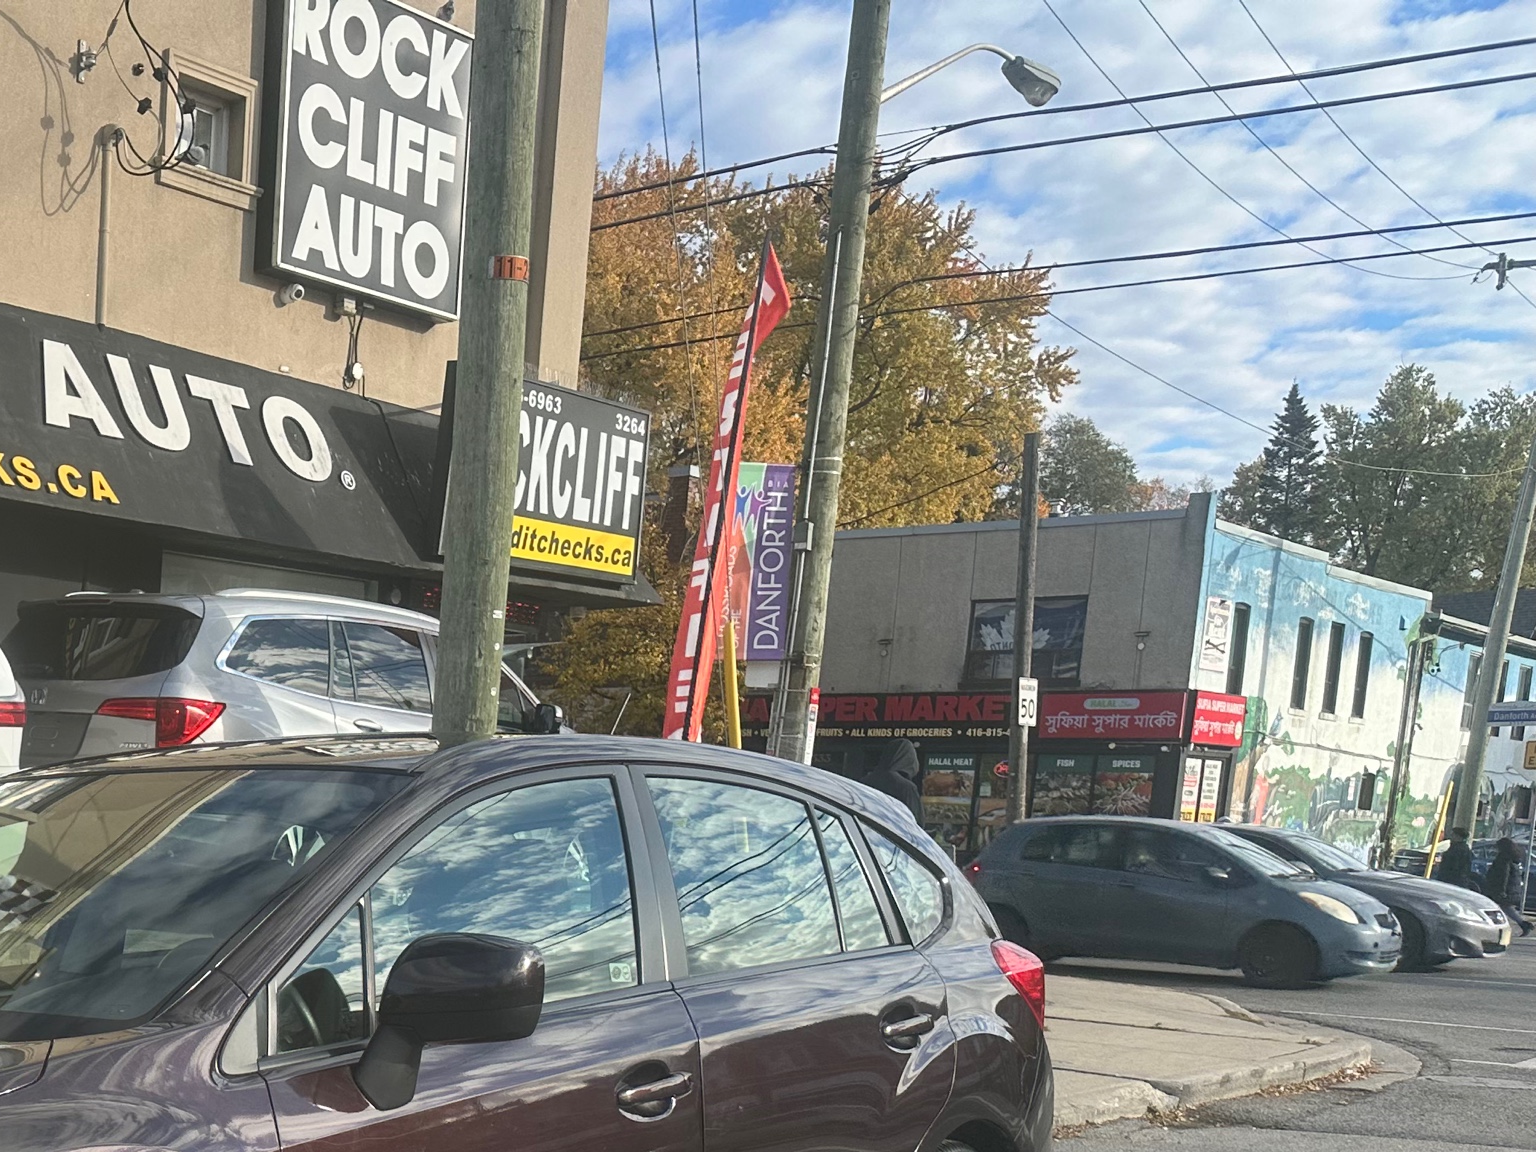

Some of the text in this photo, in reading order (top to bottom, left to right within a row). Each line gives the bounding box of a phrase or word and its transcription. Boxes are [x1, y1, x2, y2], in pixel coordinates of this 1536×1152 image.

[293, 0, 470, 120] ROCK
[298, 83, 457, 207] CLIFF
[291, 184, 450, 300] AUTO
[42, 338, 333, 482] AUTO
[615, 413, 646, 436] 3264
[767, 480, 789, 488] BIA
[753, 492, 788, 650] DANFORTH
[1021, 699, 1035, 718] 50
[1494, 712, 1529, 720] Danforth
[816, 728, 844, 737] FRUITS
[850, 728, 865, 737] ALL
[867, 728, 892, 737] KINDS
[893, 728, 906, 737] OF
[906, 728, 953, 737] GROCERIES
[1092, 713, 1131, 733] সুপার
[1056, 759, 1075, 767] FISH
[1112, 760, 1141, 768] SPICES
